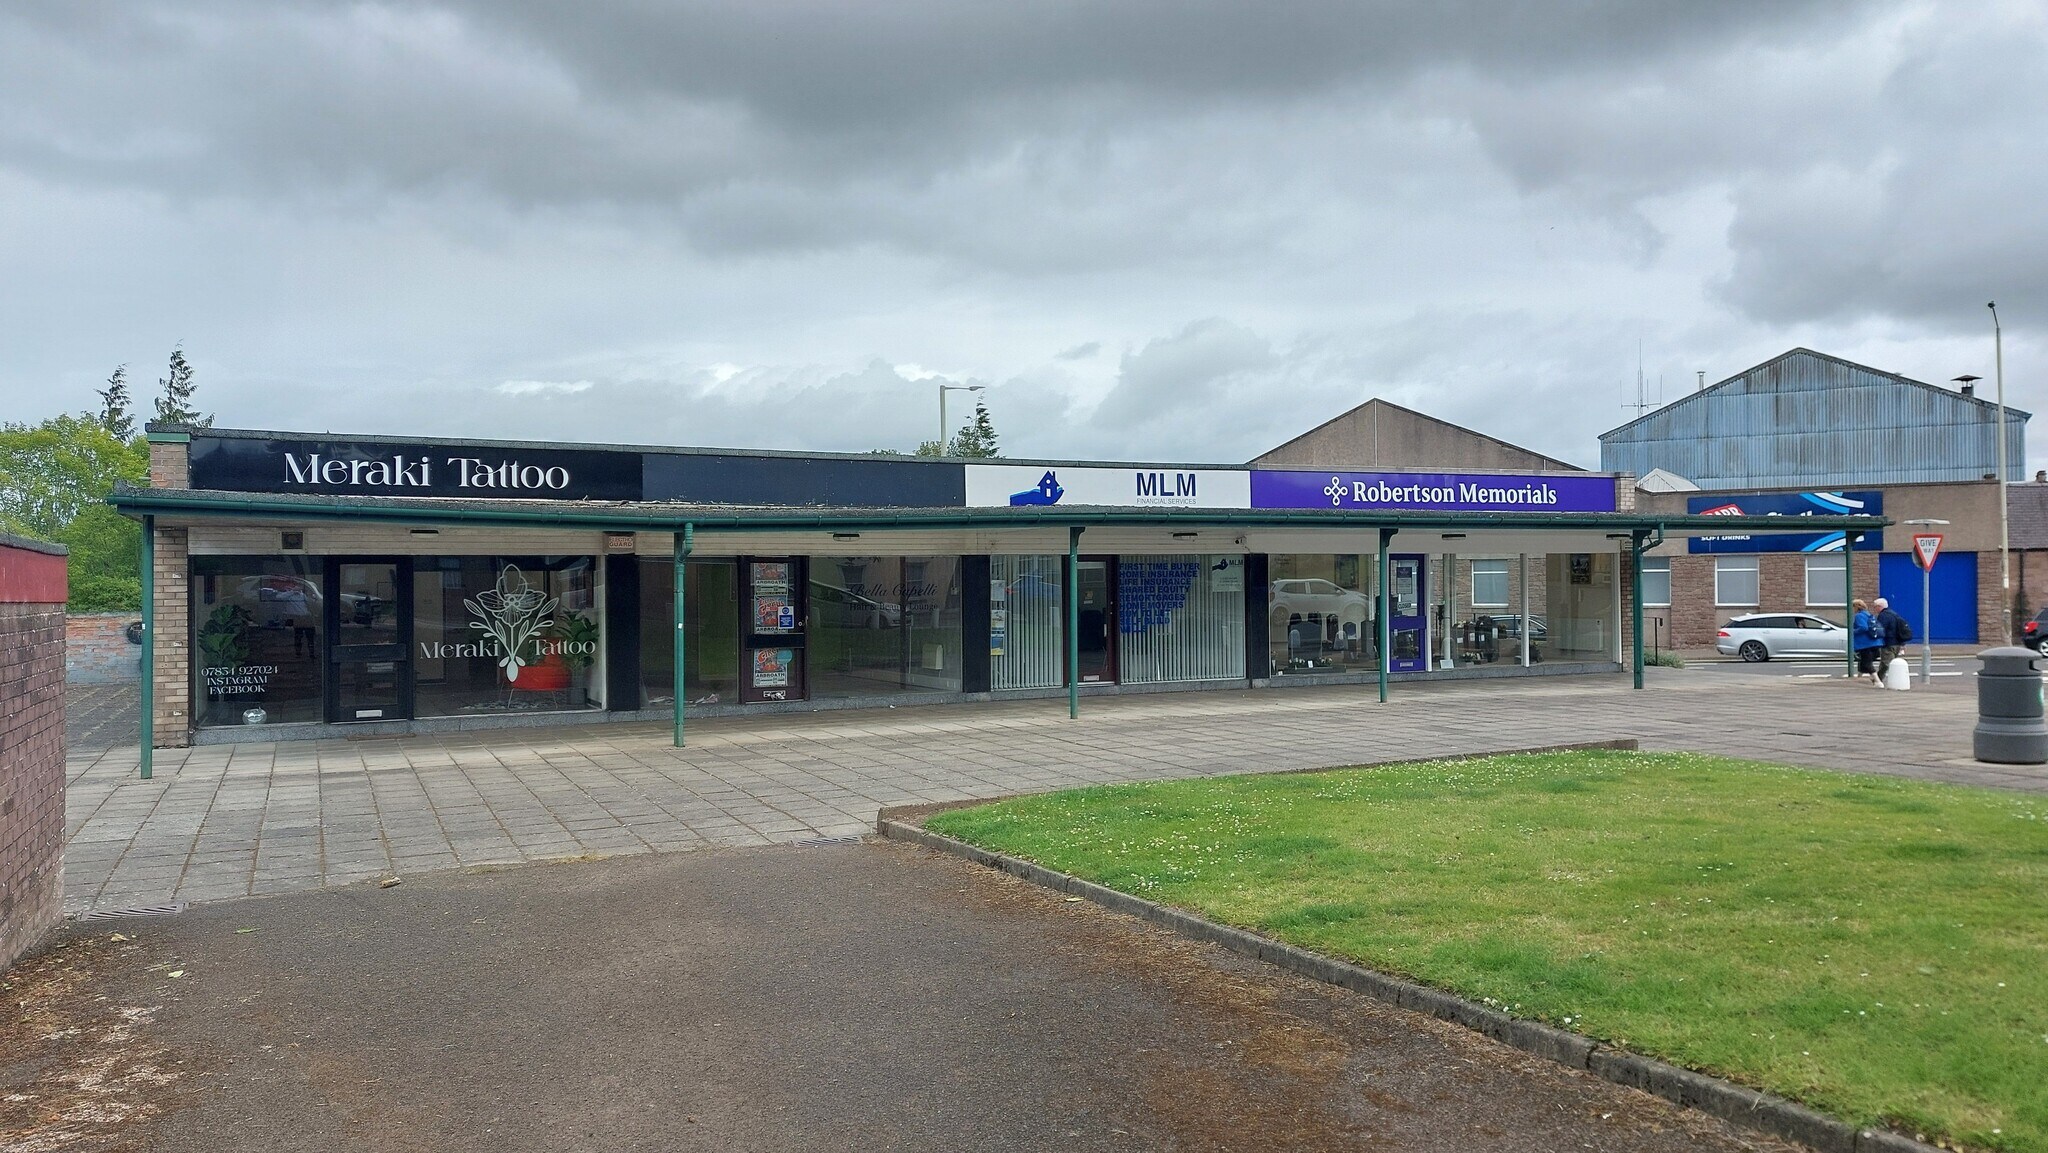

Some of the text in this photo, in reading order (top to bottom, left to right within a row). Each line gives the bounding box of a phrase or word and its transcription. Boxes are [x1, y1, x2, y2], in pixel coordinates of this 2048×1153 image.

[283, 452, 570, 490] Meraki Tattoo
[1136, 472, 1197, 497] MLM
[1352, 480, 1557, 505] Robertson Memorials
[1920, 539, 1937, 547] GIVE
[1120, 563, 1200, 571] FIRST TIME BUYER
[1119, 570, 1198, 578] HOME INSURANCE
[1120, 578, 1192, 586] LIFE INSURANCE
[849, 583, 888, 598] Bella
[1119, 585, 1190, 594] SHARED EQUITY
[1119, 594, 1186, 602] REMORTGAGES
[1148, 601, 1184, 609] MOVERS
[420, 639, 597, 659] Meraki Tattoo
[238, 665, 279, 675] 927024
[207, 675, 268, 685] INSTAGRAM
[209, 685, 265, 695] FACEBOOK
